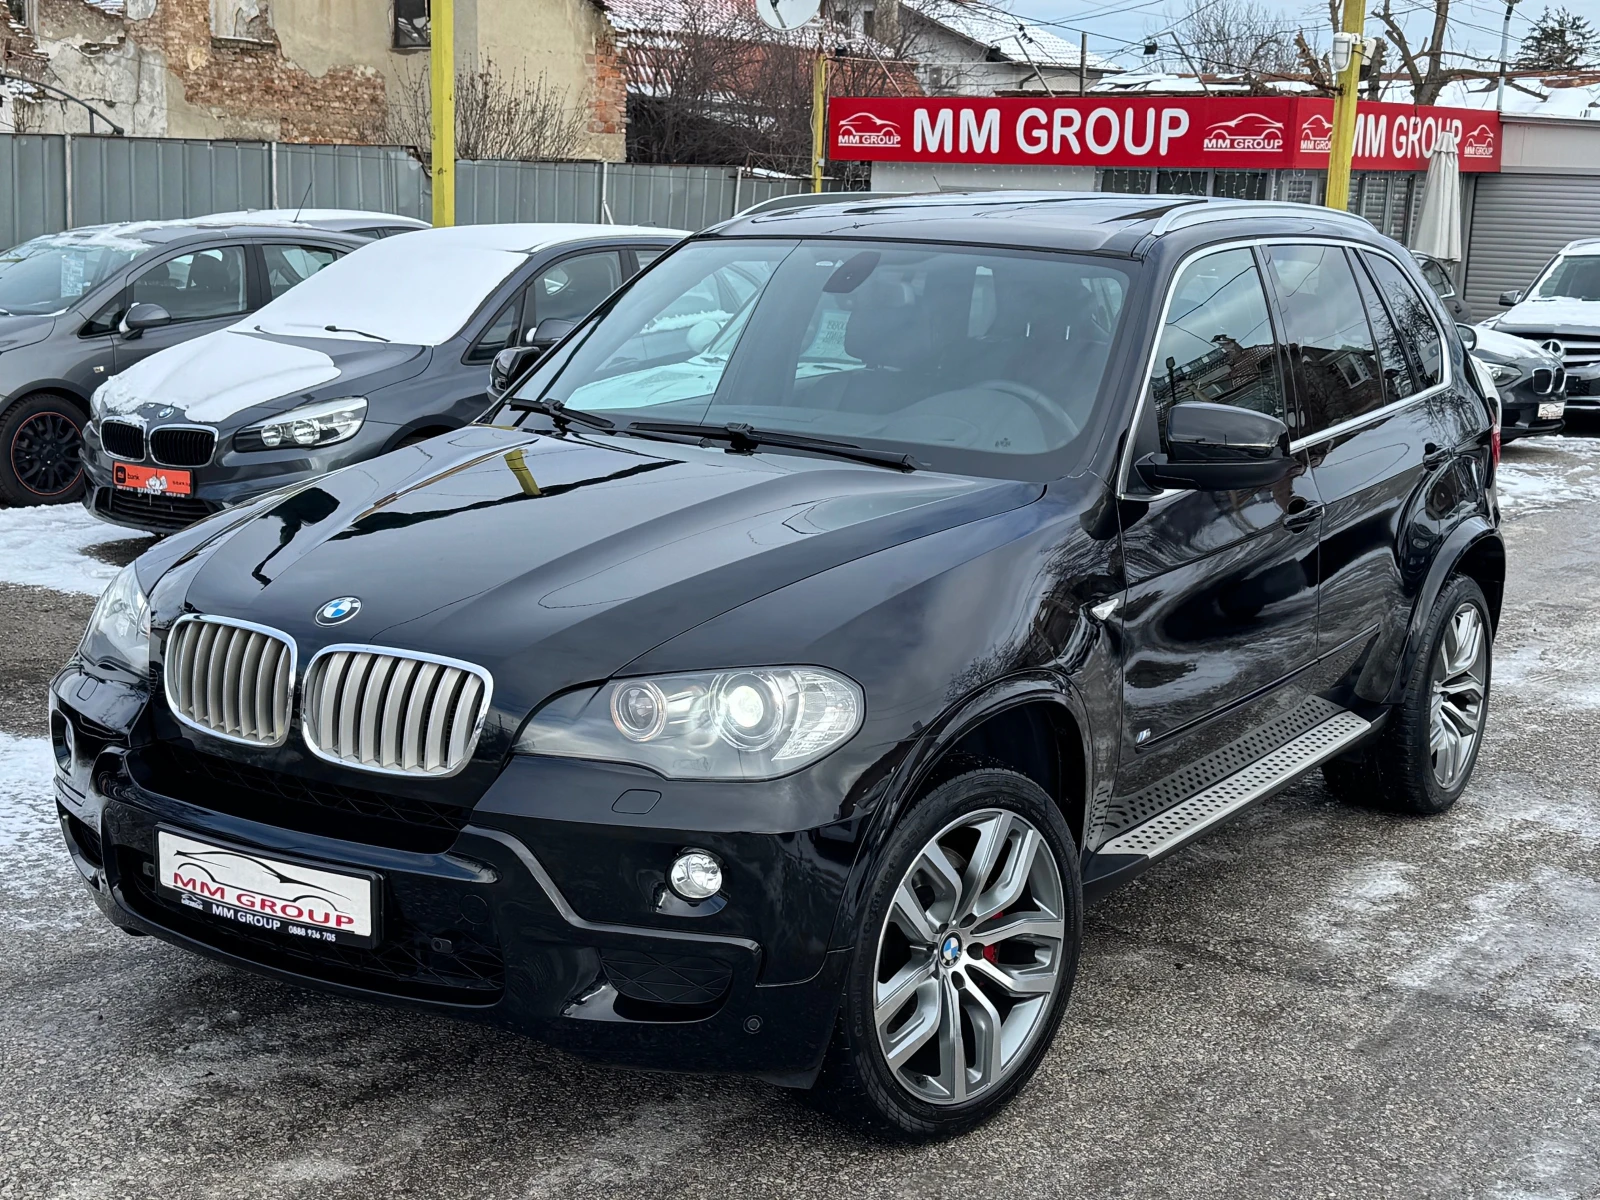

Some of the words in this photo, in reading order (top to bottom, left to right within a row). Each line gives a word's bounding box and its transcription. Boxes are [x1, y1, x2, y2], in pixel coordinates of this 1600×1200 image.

[838, 135, 860, 144] MM
[862, 135, 901, 145] GROUP
[913, 108, 1000, 154] MM
[1016, 107, 1190, 156] GROUP
[1203, 138, 1231, 149] MM
[1233, 139, 1284, 150] GROUP
[1300, 139, 1314, 150] MM
[173, 872, 226, 900] MM
[235, 893, 356, 928] GROUP
[212, 903, 235, 920] MM
[237, 912, 281, 931] GROUP
[288, 925, 306, 936] 0888
[307, 929, 321, 939] 936
[322, 931, 336, 942] 705
